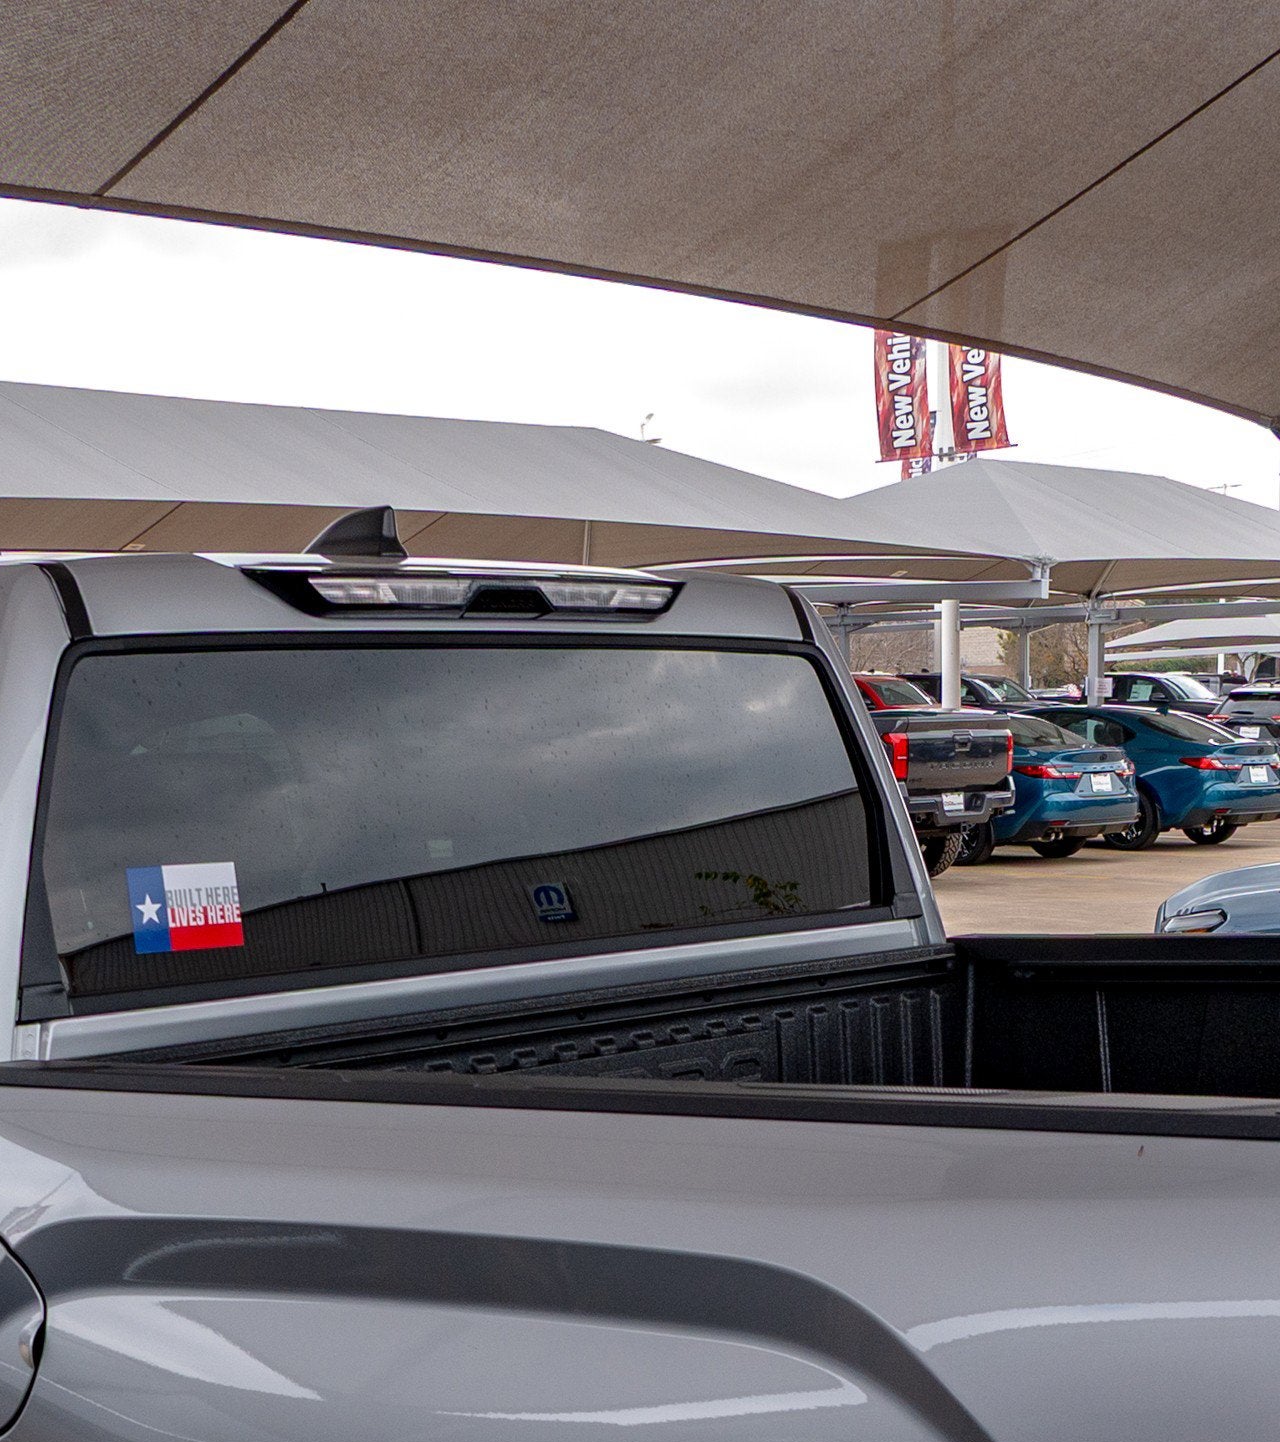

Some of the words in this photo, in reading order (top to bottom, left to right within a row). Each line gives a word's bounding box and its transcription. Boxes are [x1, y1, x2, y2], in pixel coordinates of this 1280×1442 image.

[961, 346, 986, 384] Ve
[891, 395, 917, 449] New
[966, 385, 992, 441] New
[165, 887, 203, 909] BUILT
[205, 885, 240, 906] HERE
[167, 905, 206, 928] LIVES
[206, 903, 242, 925] HERE
